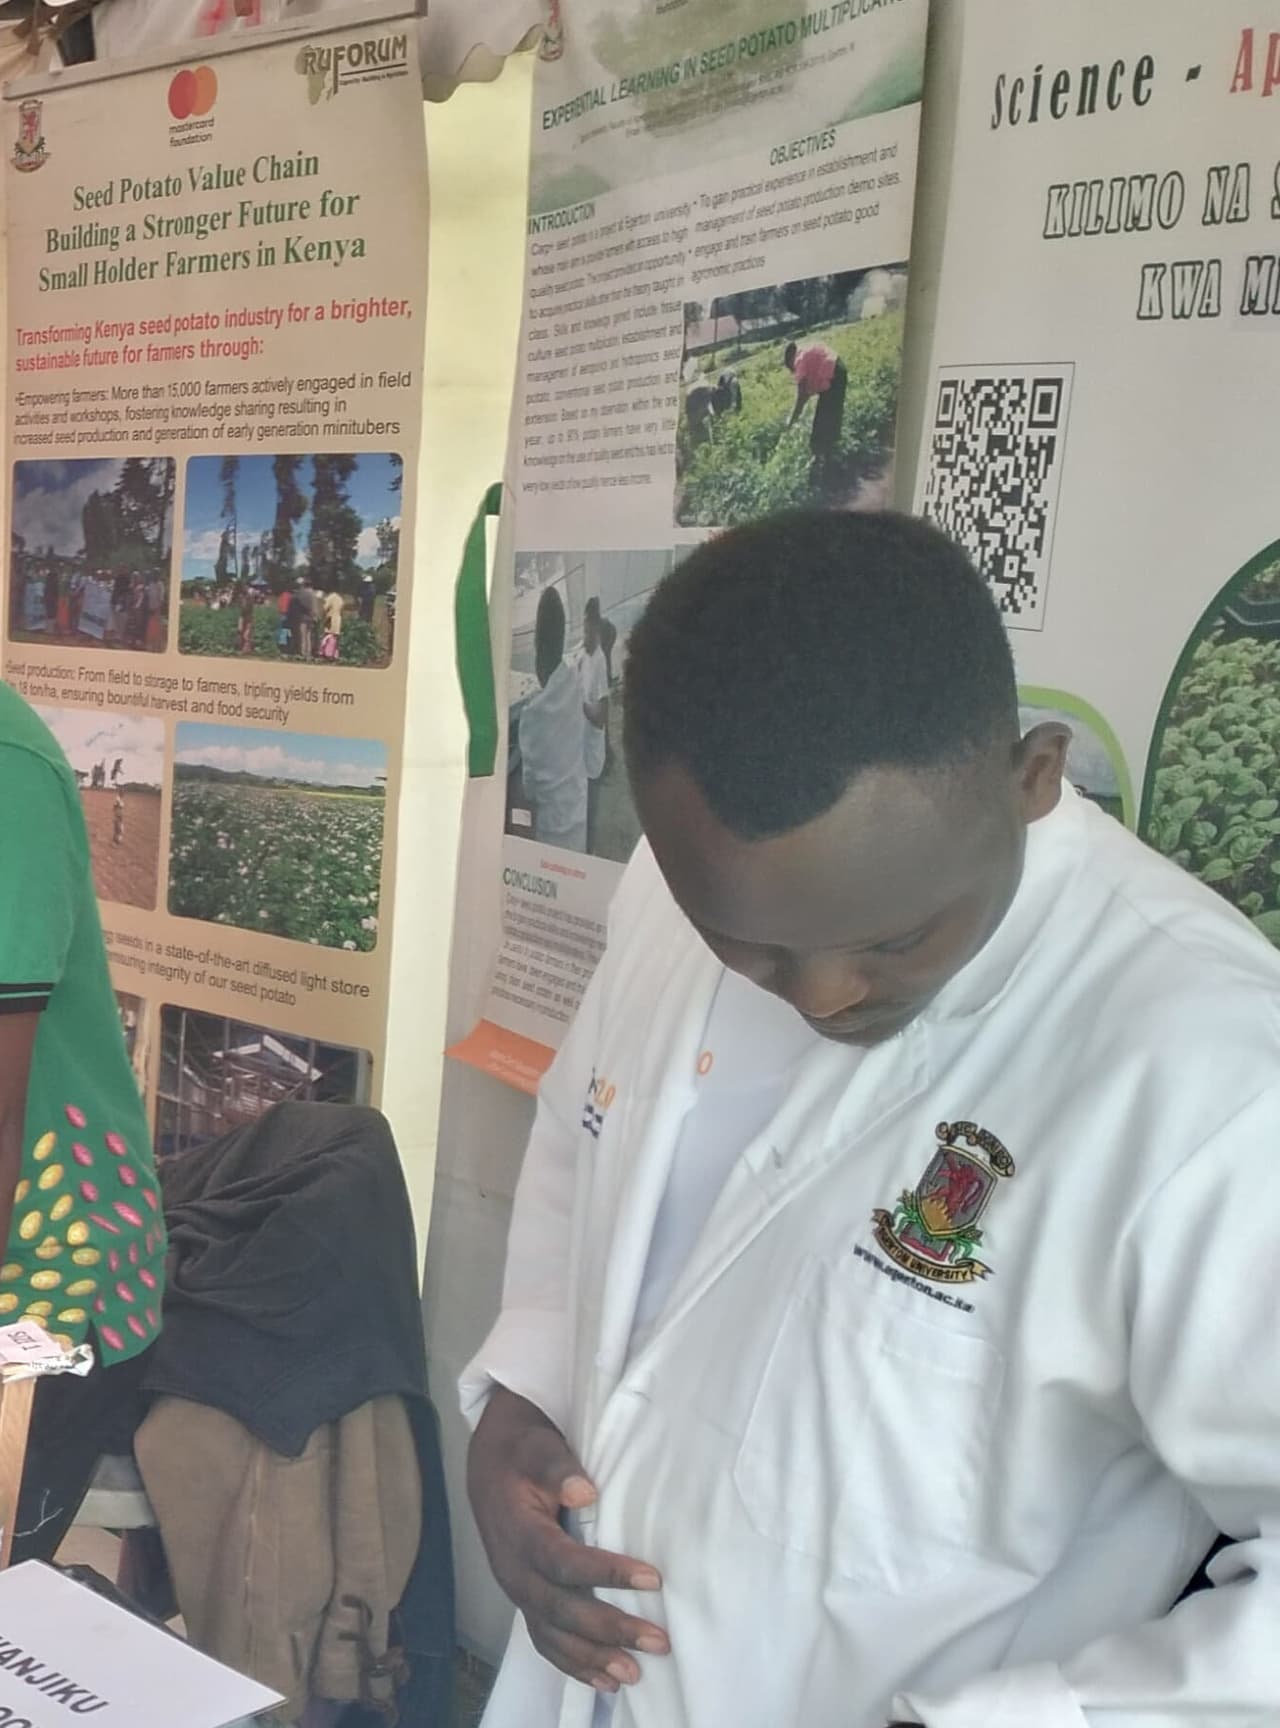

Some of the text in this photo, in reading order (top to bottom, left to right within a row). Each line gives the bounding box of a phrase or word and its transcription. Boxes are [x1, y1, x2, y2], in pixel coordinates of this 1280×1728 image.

[304, 35, 407, 96] RUFORUM
[543, 0, 903, 130] EXPERIENTIAL LEARNING IN SEED POTATO MULTIPLICA
[990, 54, 1154, 131] Science
[169, 117, 215, 134] mastercard
[169, 132, 213, 147] foundation
[770, 129, 836, 166] OBJECTIVES
[73, 150, 320, 211] Seed Potato Value Chain
[1043, 163, 1252, 239] KILIMO NA
[46, 189, 361, 253] Building a Stronger Future for
[529, 202, 596, 235] INTRODUCTION
[39, 235, 366, 293] Small Holder Farmers in Kenya
[1137, 259, 1222, 320] KWA
[16, 297, 413, 347] Transforming Kenya seed potato industry for a brighter,
[15, 336, 264, 372] sustainable future for farmers through:
[112, 370, 412, 401] More than 15,000 farmers actively engaged in field
[323, 418, 401, 436] minitubers
[218, 700, 290, 726] food security
[503, 866, 558, 899] CONCLUSION
[165, 943, 370, 998] state-of-the-art diffused light store
[910, 1258, 969, 1280] UNIVERSITY
